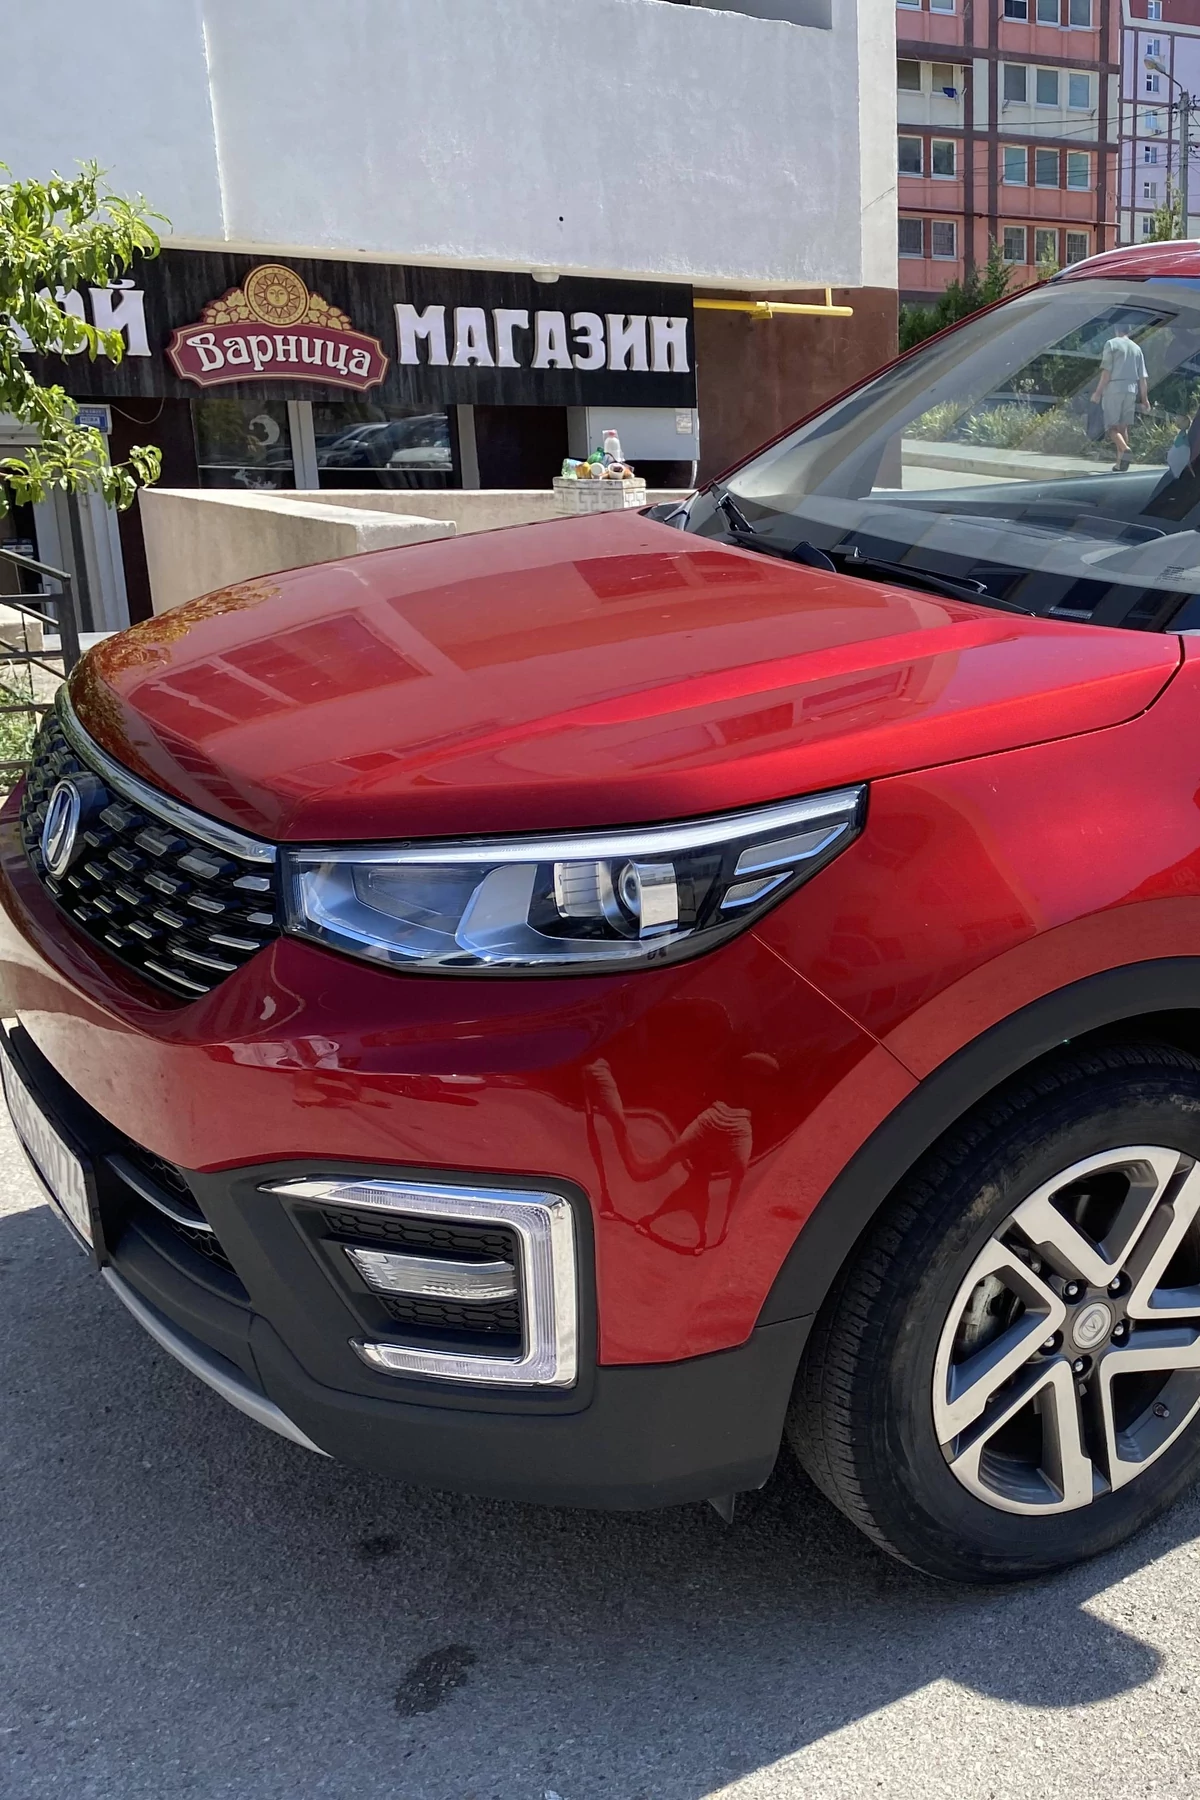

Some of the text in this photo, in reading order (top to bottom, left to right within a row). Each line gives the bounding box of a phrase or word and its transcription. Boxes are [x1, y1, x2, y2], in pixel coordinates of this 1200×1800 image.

[0, 278, 152, 357] ОЙ
[394, 303, 690, 373] МАГАЗИН
[186, 332, 371, 378] Варница
